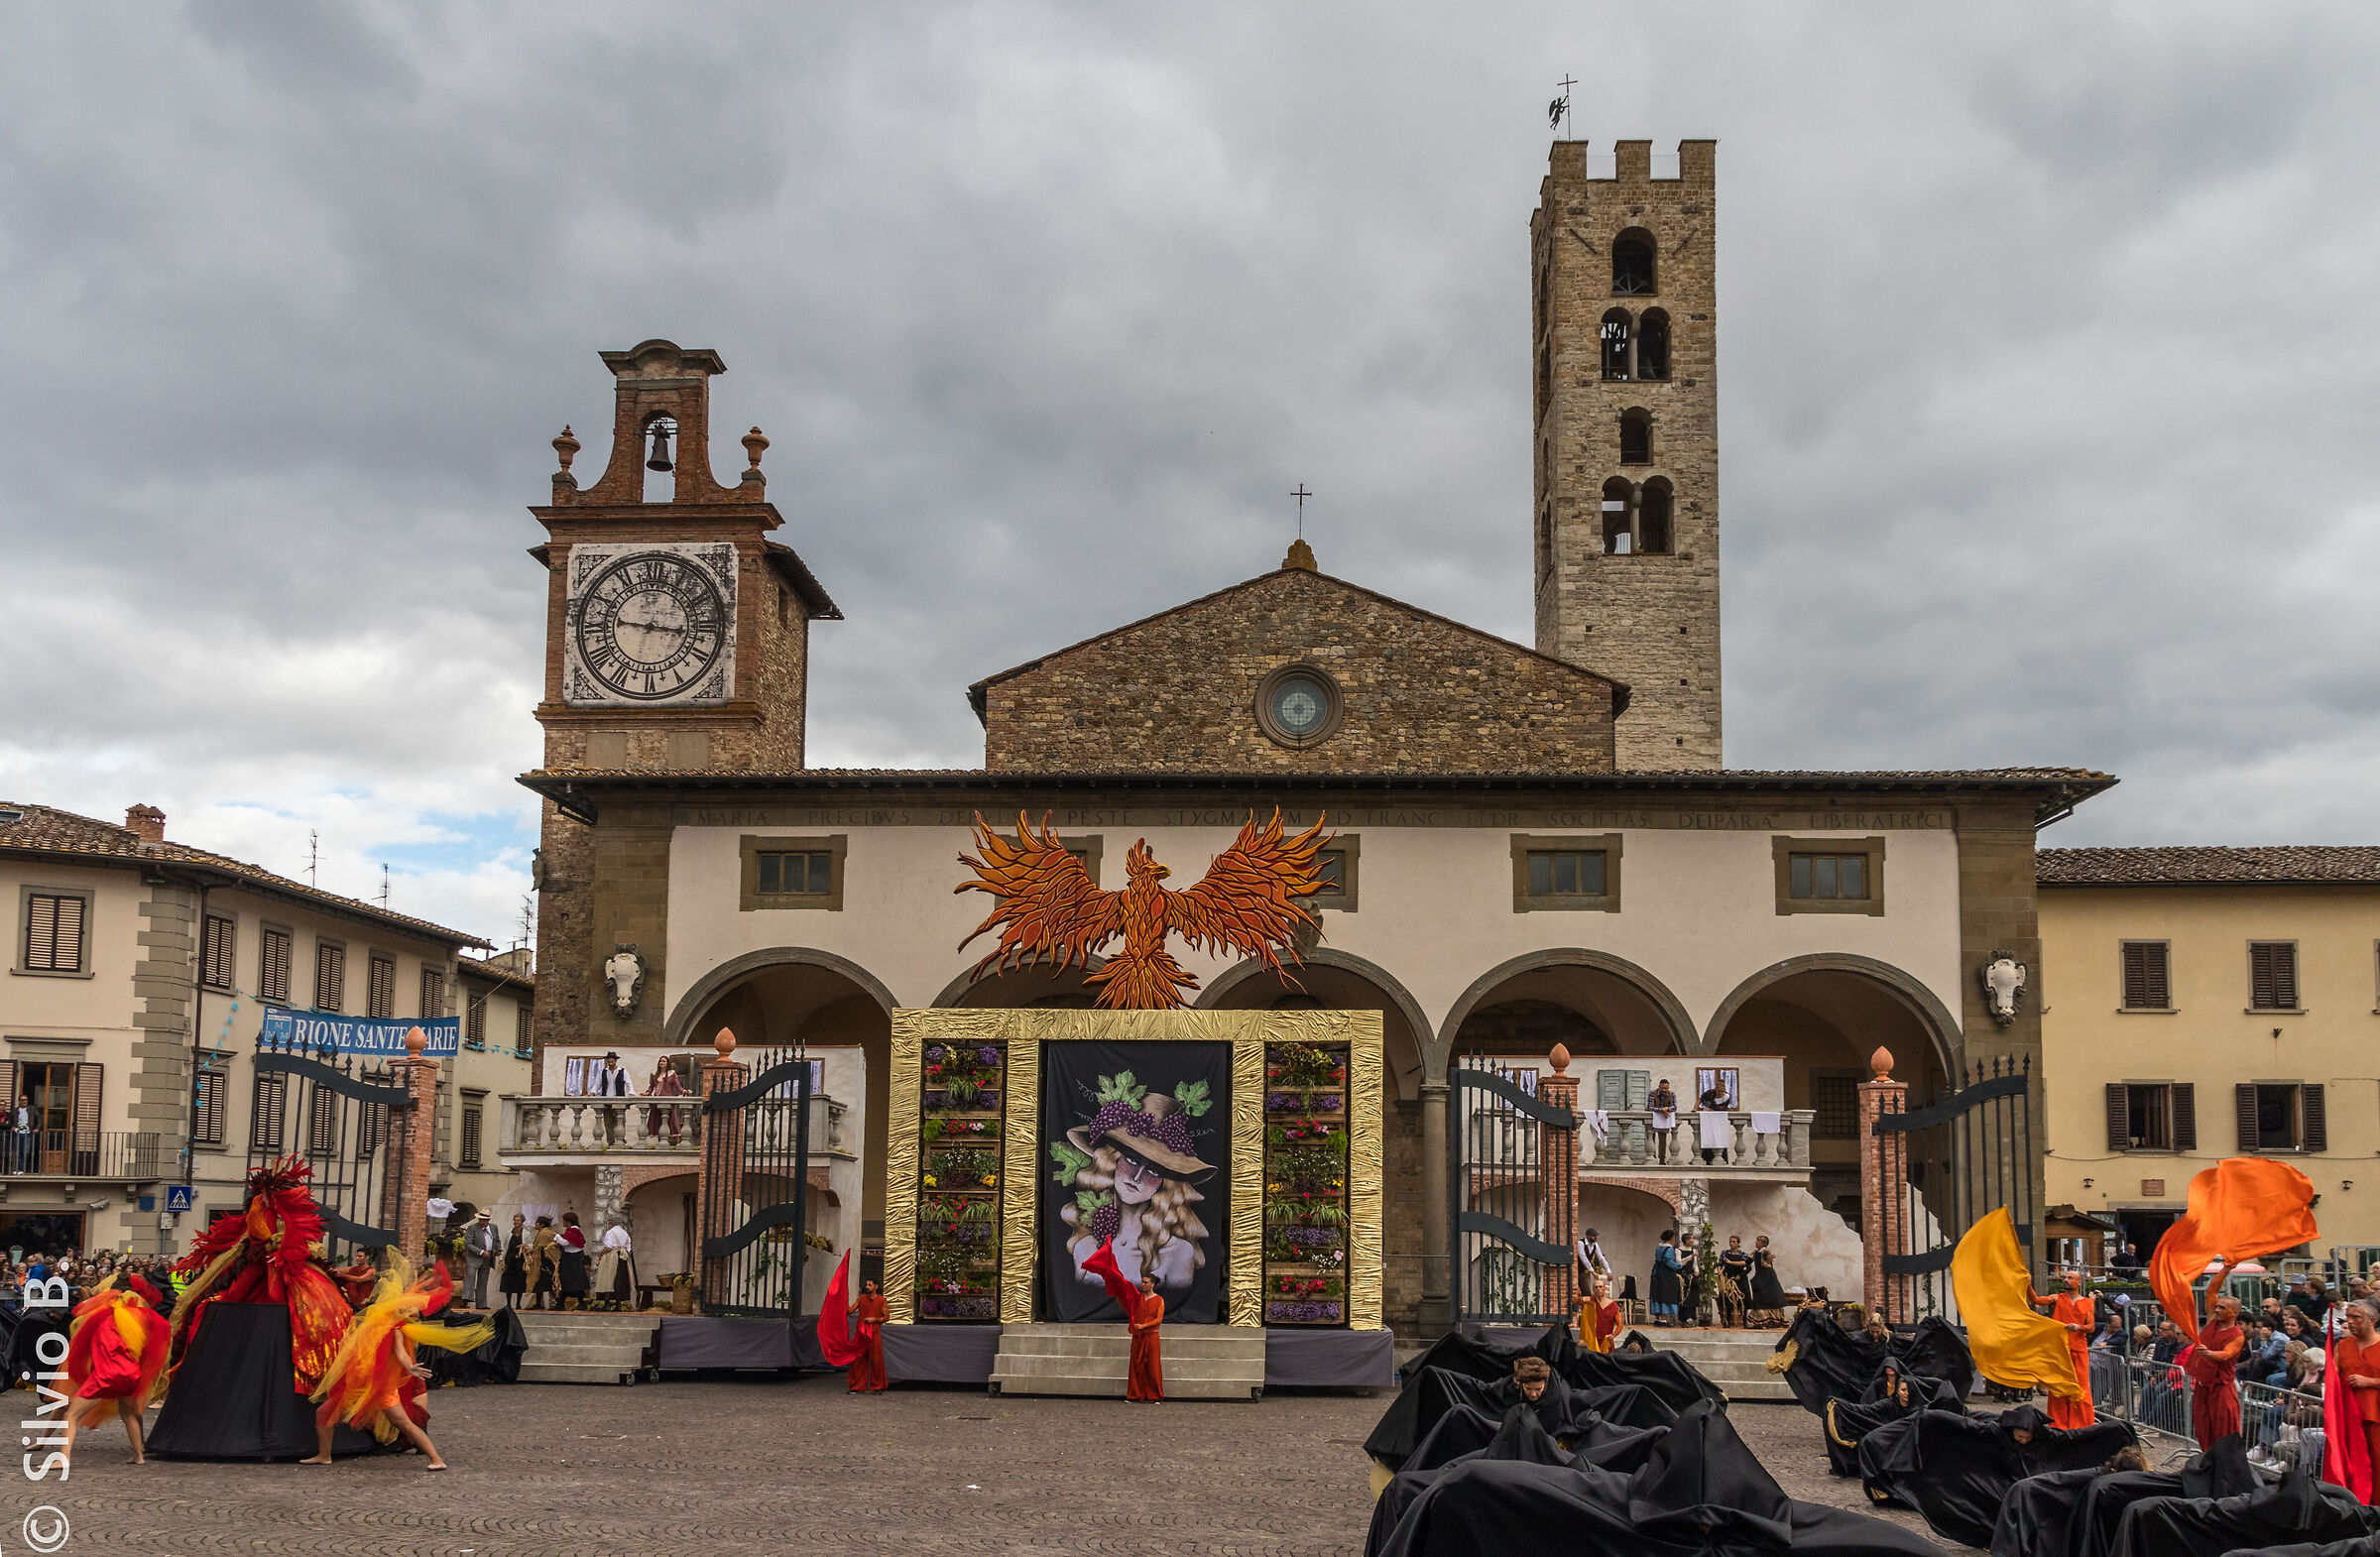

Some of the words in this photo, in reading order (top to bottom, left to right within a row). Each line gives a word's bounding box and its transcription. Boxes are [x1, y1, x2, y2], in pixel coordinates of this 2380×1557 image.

[808, 809, 909, 825] PRECIBVS
[1067, 810, 1132, 825] PESTE
[1164, 809, 1301, 825] STYGMATM
[1549, 811, 1648, 827] SOCIETAS
[1810, 813, 1943, 829] LIBERATRICI
[295, 1018, 353, 1048] RIONE
[355, 1023, 407, 1050] SANTE
[423, 1025, 458, 1051] ARIE
